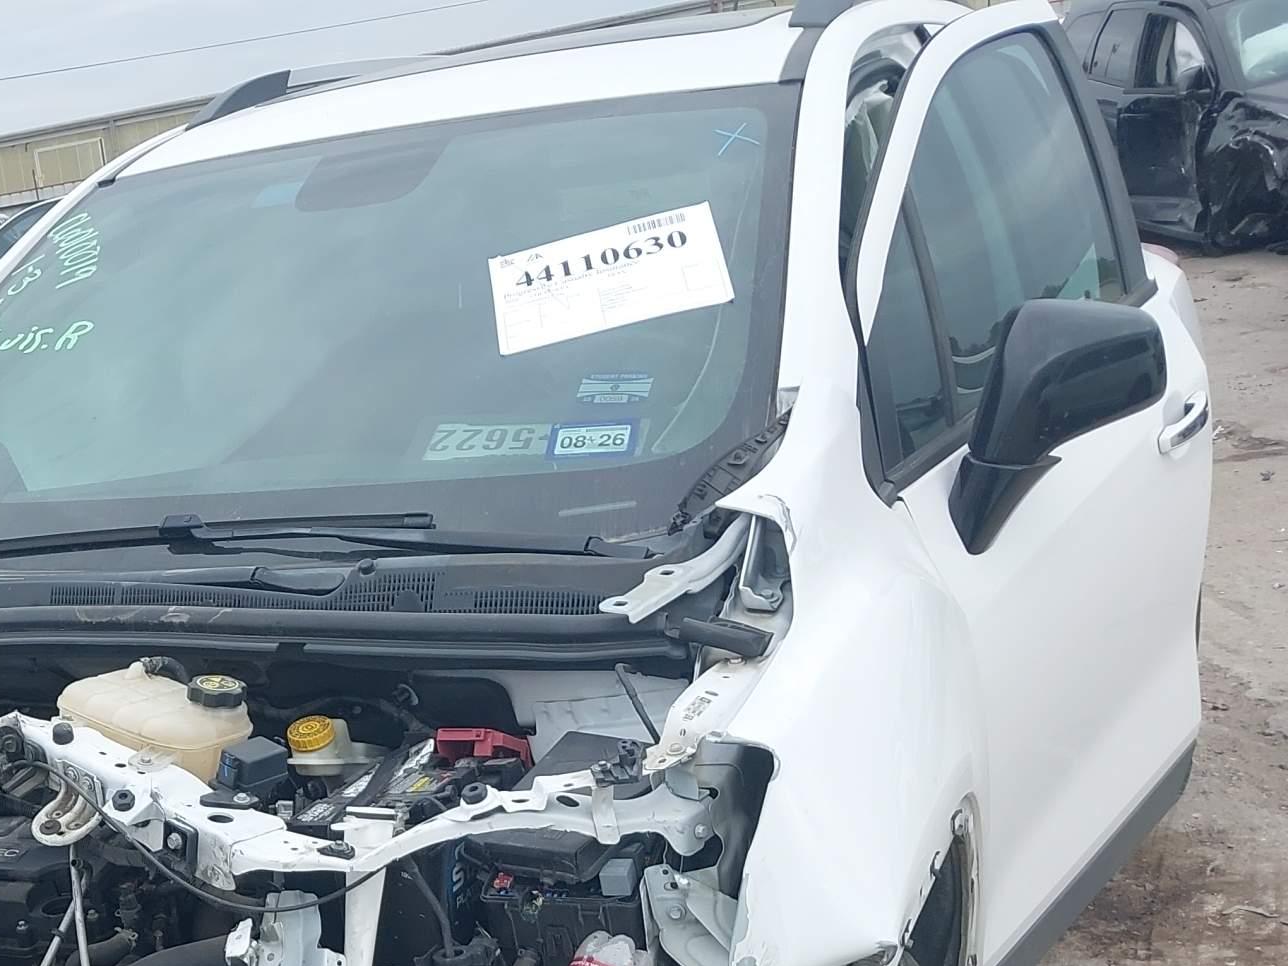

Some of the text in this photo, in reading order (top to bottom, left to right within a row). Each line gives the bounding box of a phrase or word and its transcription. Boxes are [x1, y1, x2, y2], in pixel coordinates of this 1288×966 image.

[515, 230, 688, 287] 44110630
[559, 433, 626, 449] 08 26
